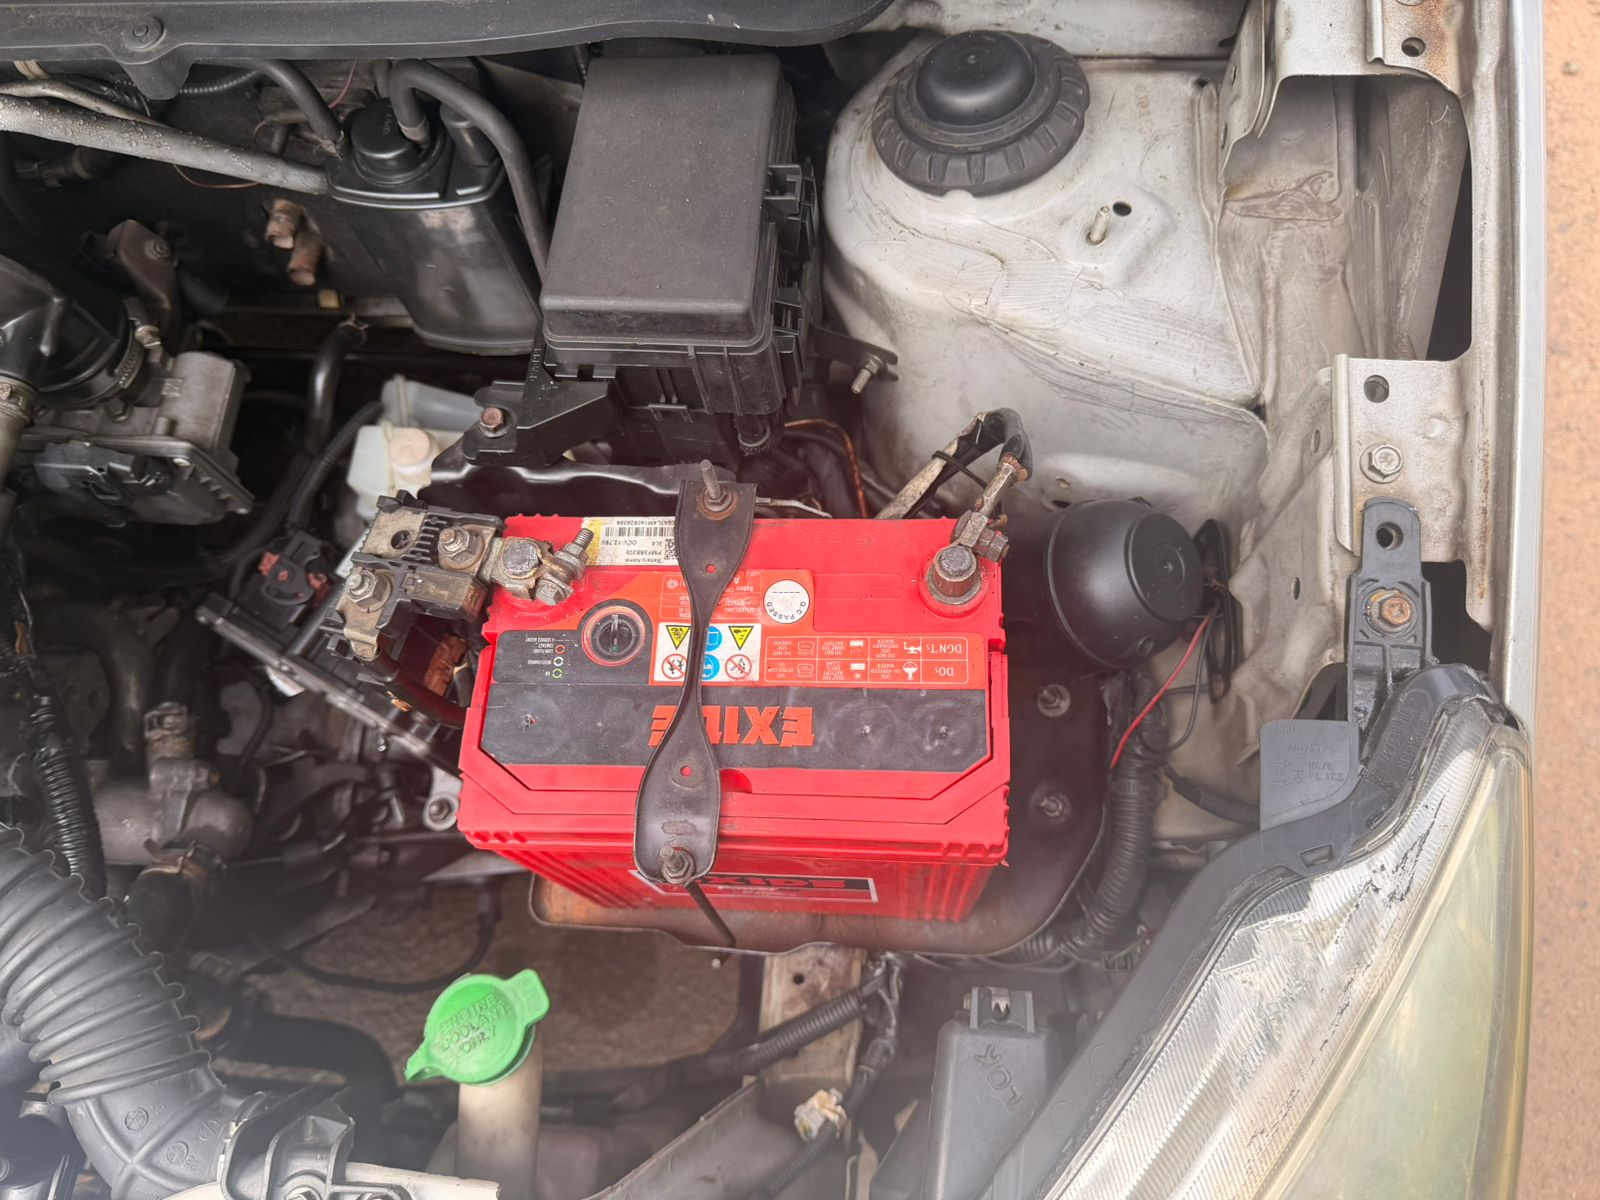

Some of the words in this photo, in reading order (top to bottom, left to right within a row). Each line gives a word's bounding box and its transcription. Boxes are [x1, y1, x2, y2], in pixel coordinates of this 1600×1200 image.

[766, 602, 795, 620] PASSED
[934, 666, 954, 677] DOs
[695, 876, 846, 888] XIDE
[439, 1002, 508, 1052] COOLANT
